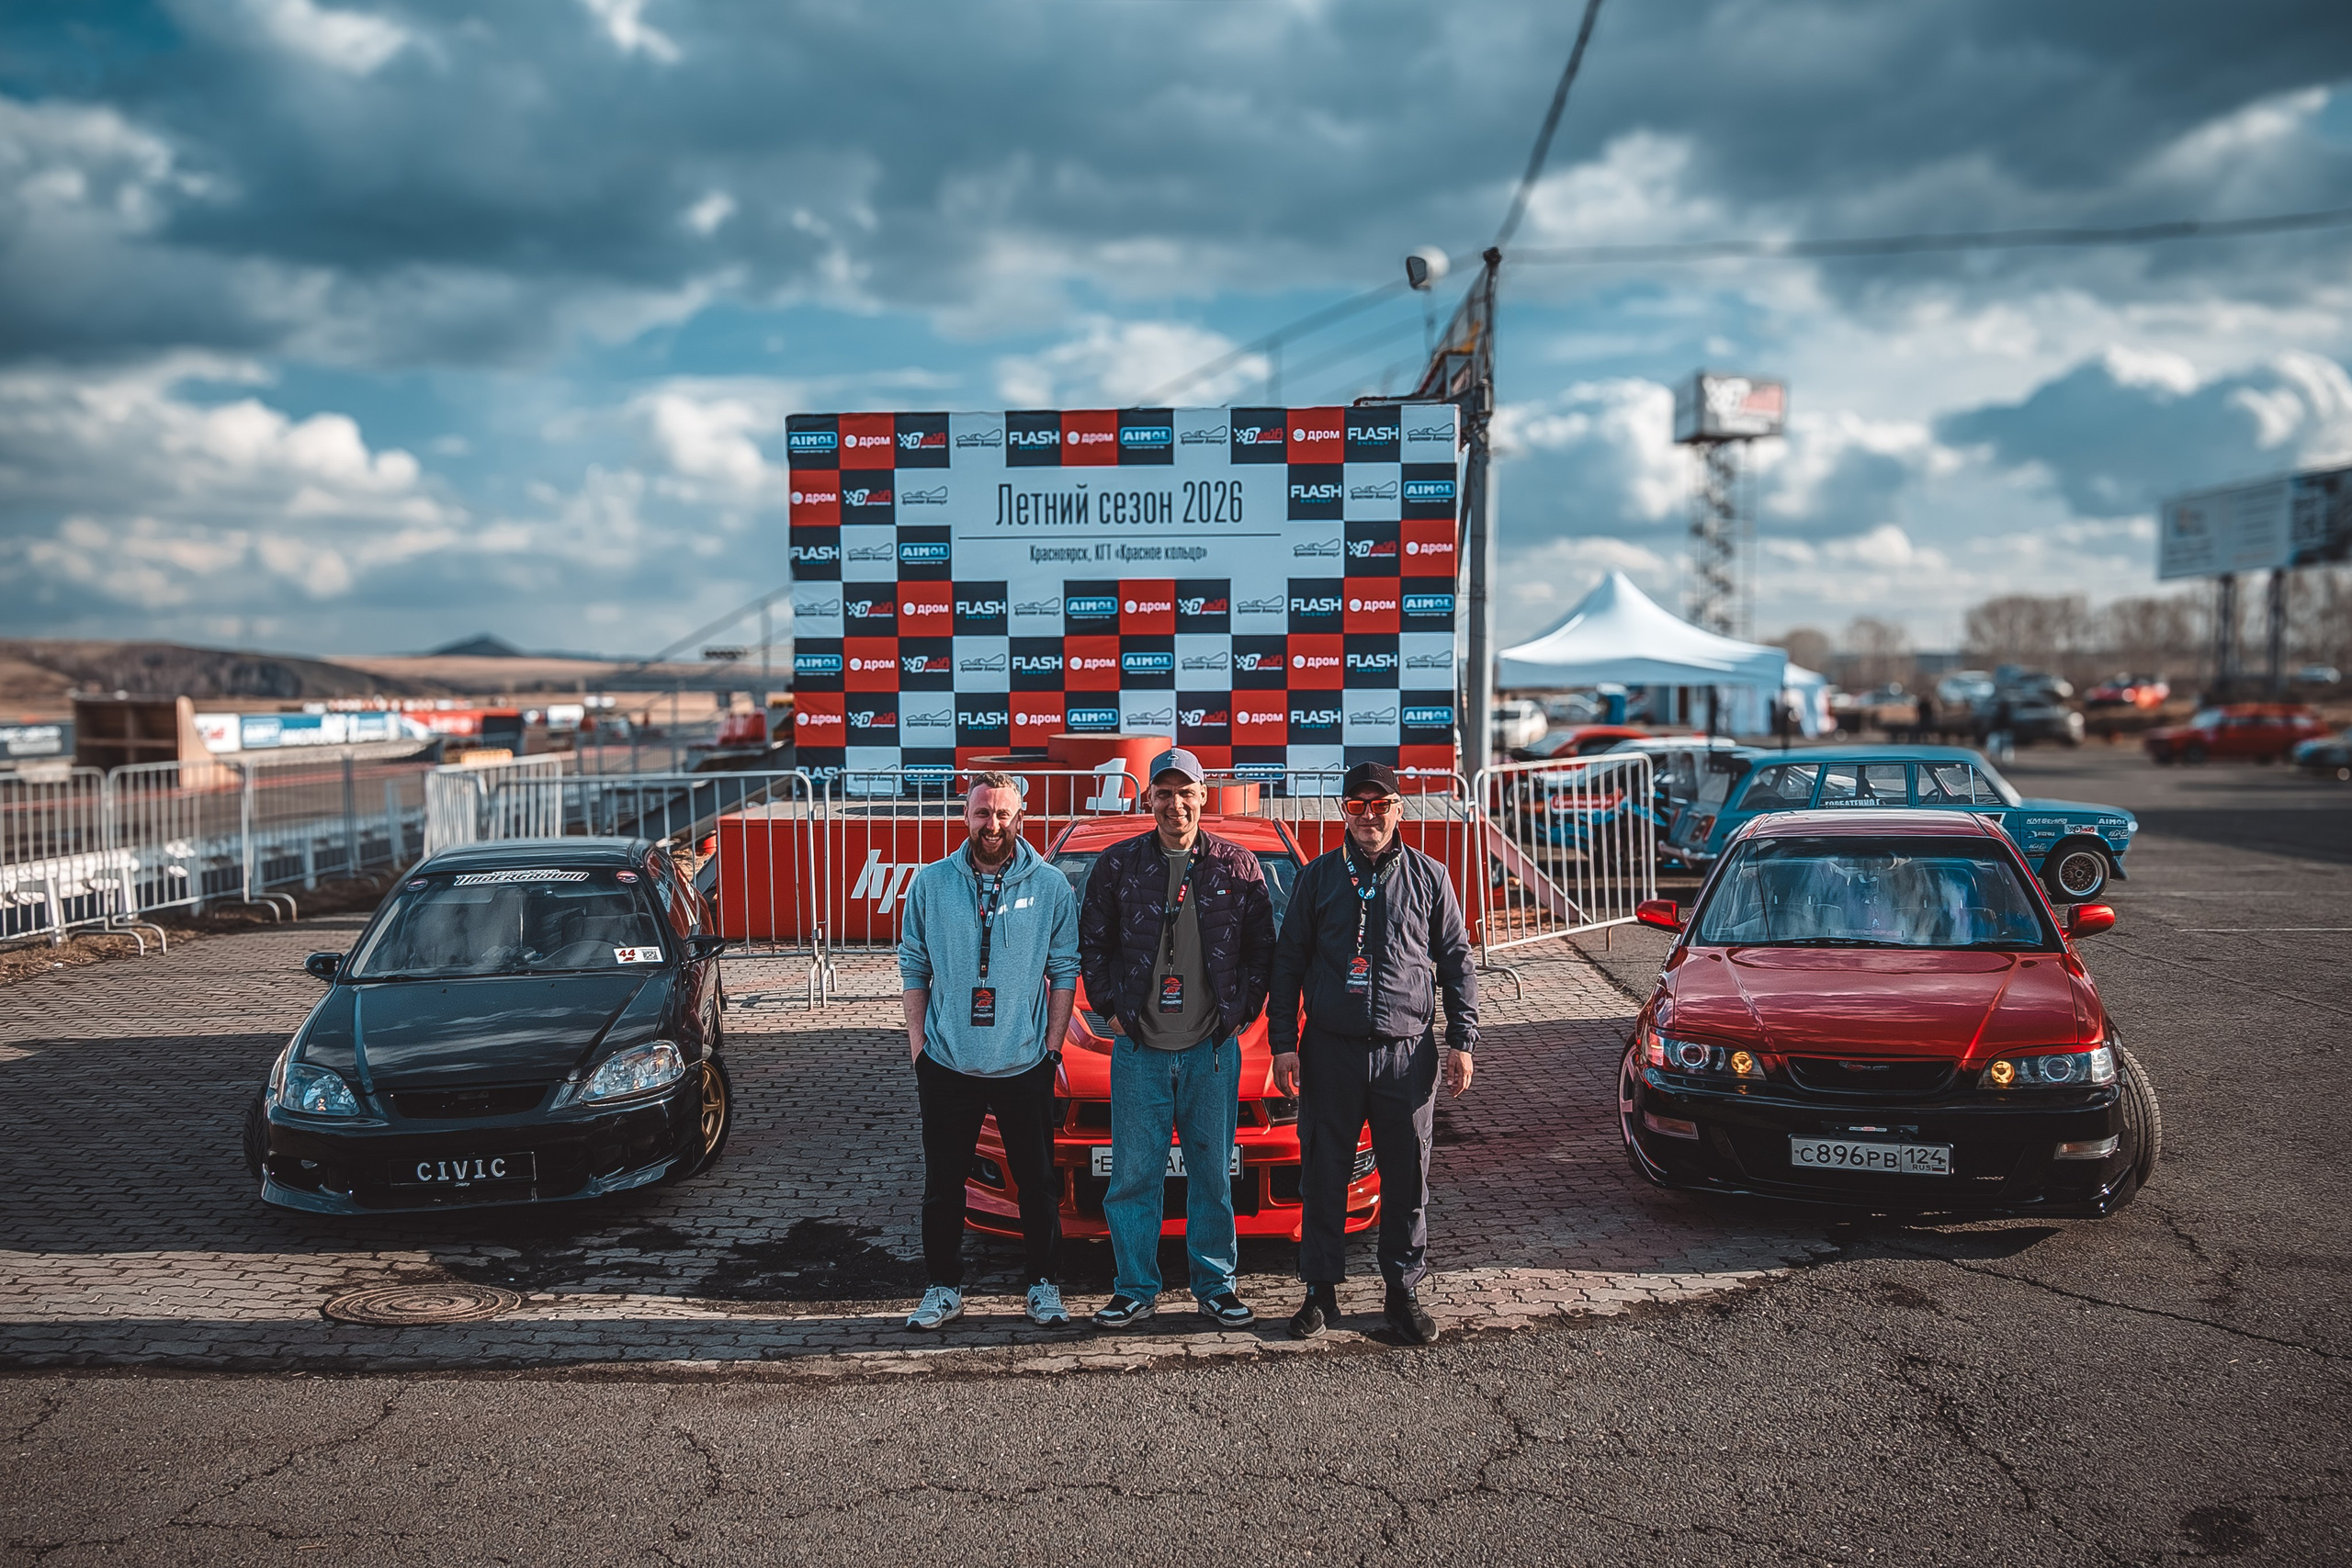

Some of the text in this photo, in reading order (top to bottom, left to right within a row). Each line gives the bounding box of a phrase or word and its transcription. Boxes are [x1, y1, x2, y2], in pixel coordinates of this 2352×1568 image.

[1009, 431, 1060, 445] FLASH
[1124, 431, 1169, 441] AIMOL
[1307, 430, 1340, 442] дром
[1348, 426, 1398, 441] FLASH
[790, 435, 834, 445] AIMOL
[858, 436, 891, 448] дром
[1081, 434, 1114, 445] дром
[1291, 485, 1341, 498] FLASH
[1408, 485, 1452, 494] AIMOL
[805, 493, 837, 505] дром
[996, 480, 1243, 525] Летний сезон 2026
[902, 547, 946, 557] AIMOL
[1420, 544, 1453, 555] дром
[956, 601, 1007, 615] FLASH
[1069, 601, 1114, 611] AIMOL
[1139, 603, 1170, 614] дром
[1291, 598, 1341, 612] FLASH
[1363, 601, 1396, 612] дром
[1406, 598, 1451, 608] AIMOL
[917, 604, 949, 615] дром
[795, 658, 840, 668] AIMOL
[864, 660, 895, 671] дром
[1012, 656, 1063, 670] FLASH
[1084, 659, 1115, 671] дром
[1125, 656, 1170, 666] AIMOL
[1306, 657, 1340, 669] дром
[1347, 654, 1397, 668] FLASH
[810, 715, 842, 726] дром
[957, 712, 1009, 726] FLASH
[1029, 715, 1061, 726] дром
[1070, 713, 1115, 722] AIMOL
[1251, 713, 1283, 725] дром
[1290, 710, 1341, 724] FLASH
[1406, 711, 1450, 720] AIMOL
[1085, 758, 1131, 811] 1
[618, 949, 636, 957] 44
[1904, 1148, 1943, 1165] 124
[417, 1157, 506, 1181] CIVIC
